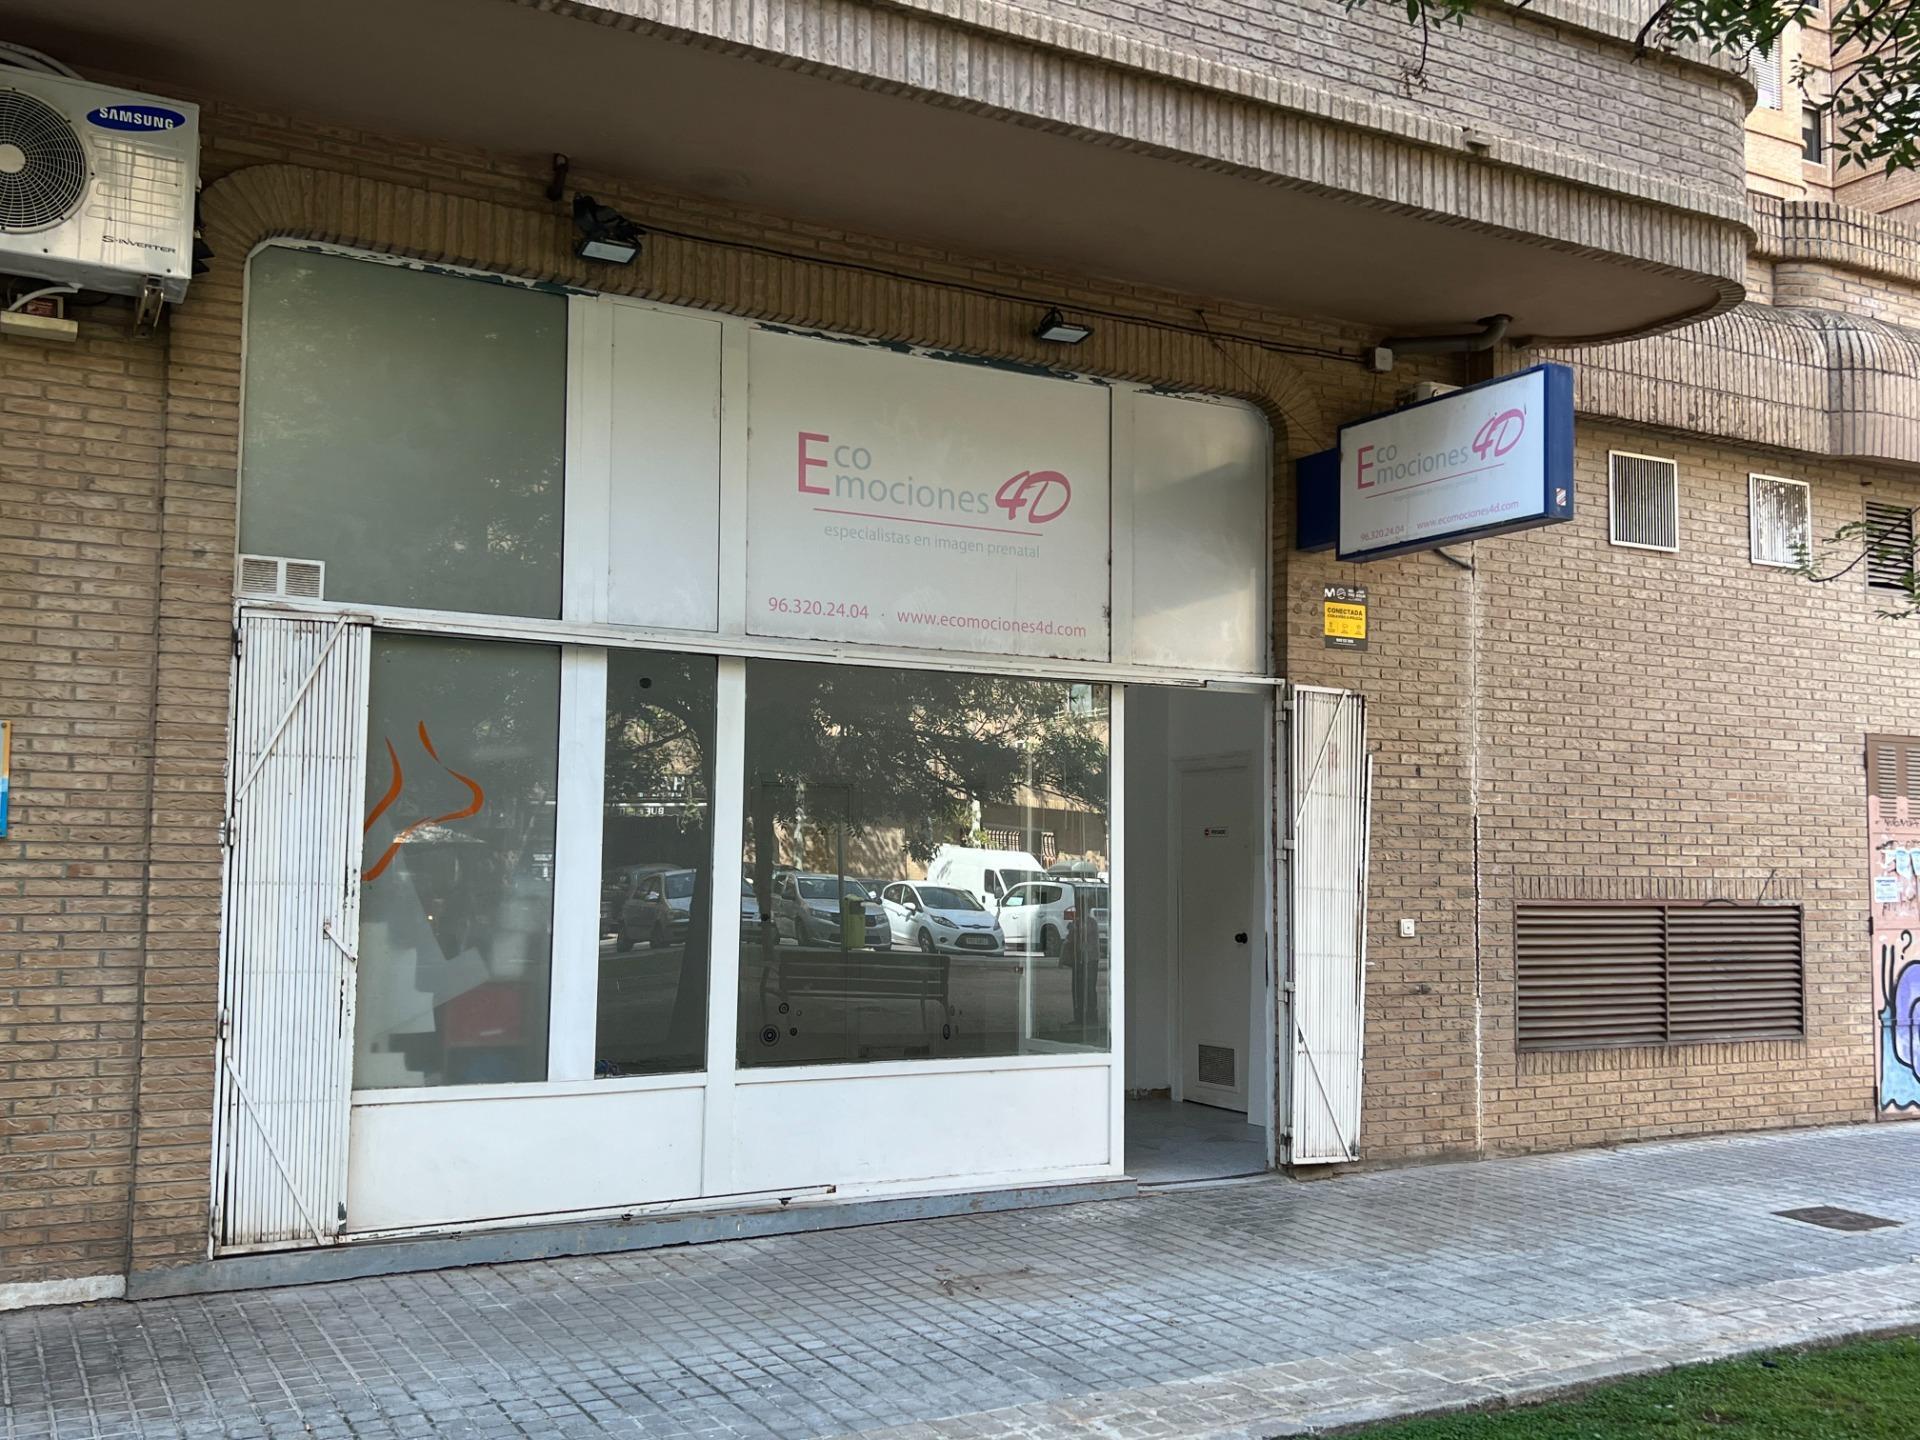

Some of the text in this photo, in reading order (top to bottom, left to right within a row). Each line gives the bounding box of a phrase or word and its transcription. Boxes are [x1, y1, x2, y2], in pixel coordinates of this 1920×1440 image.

[100, 107, 174, 130] SAMSUNG
[1360, 500, 1520, 542] 96.320.24.04 www.ecomociones4d.com
[824, 524, 1041, 559] especialistas en imagen prenatal
[768, 597, 1087, 638] 96.320.24.04 www.ecomociones4d.com
[1327, 607, 1363, 616] CONECTADA
